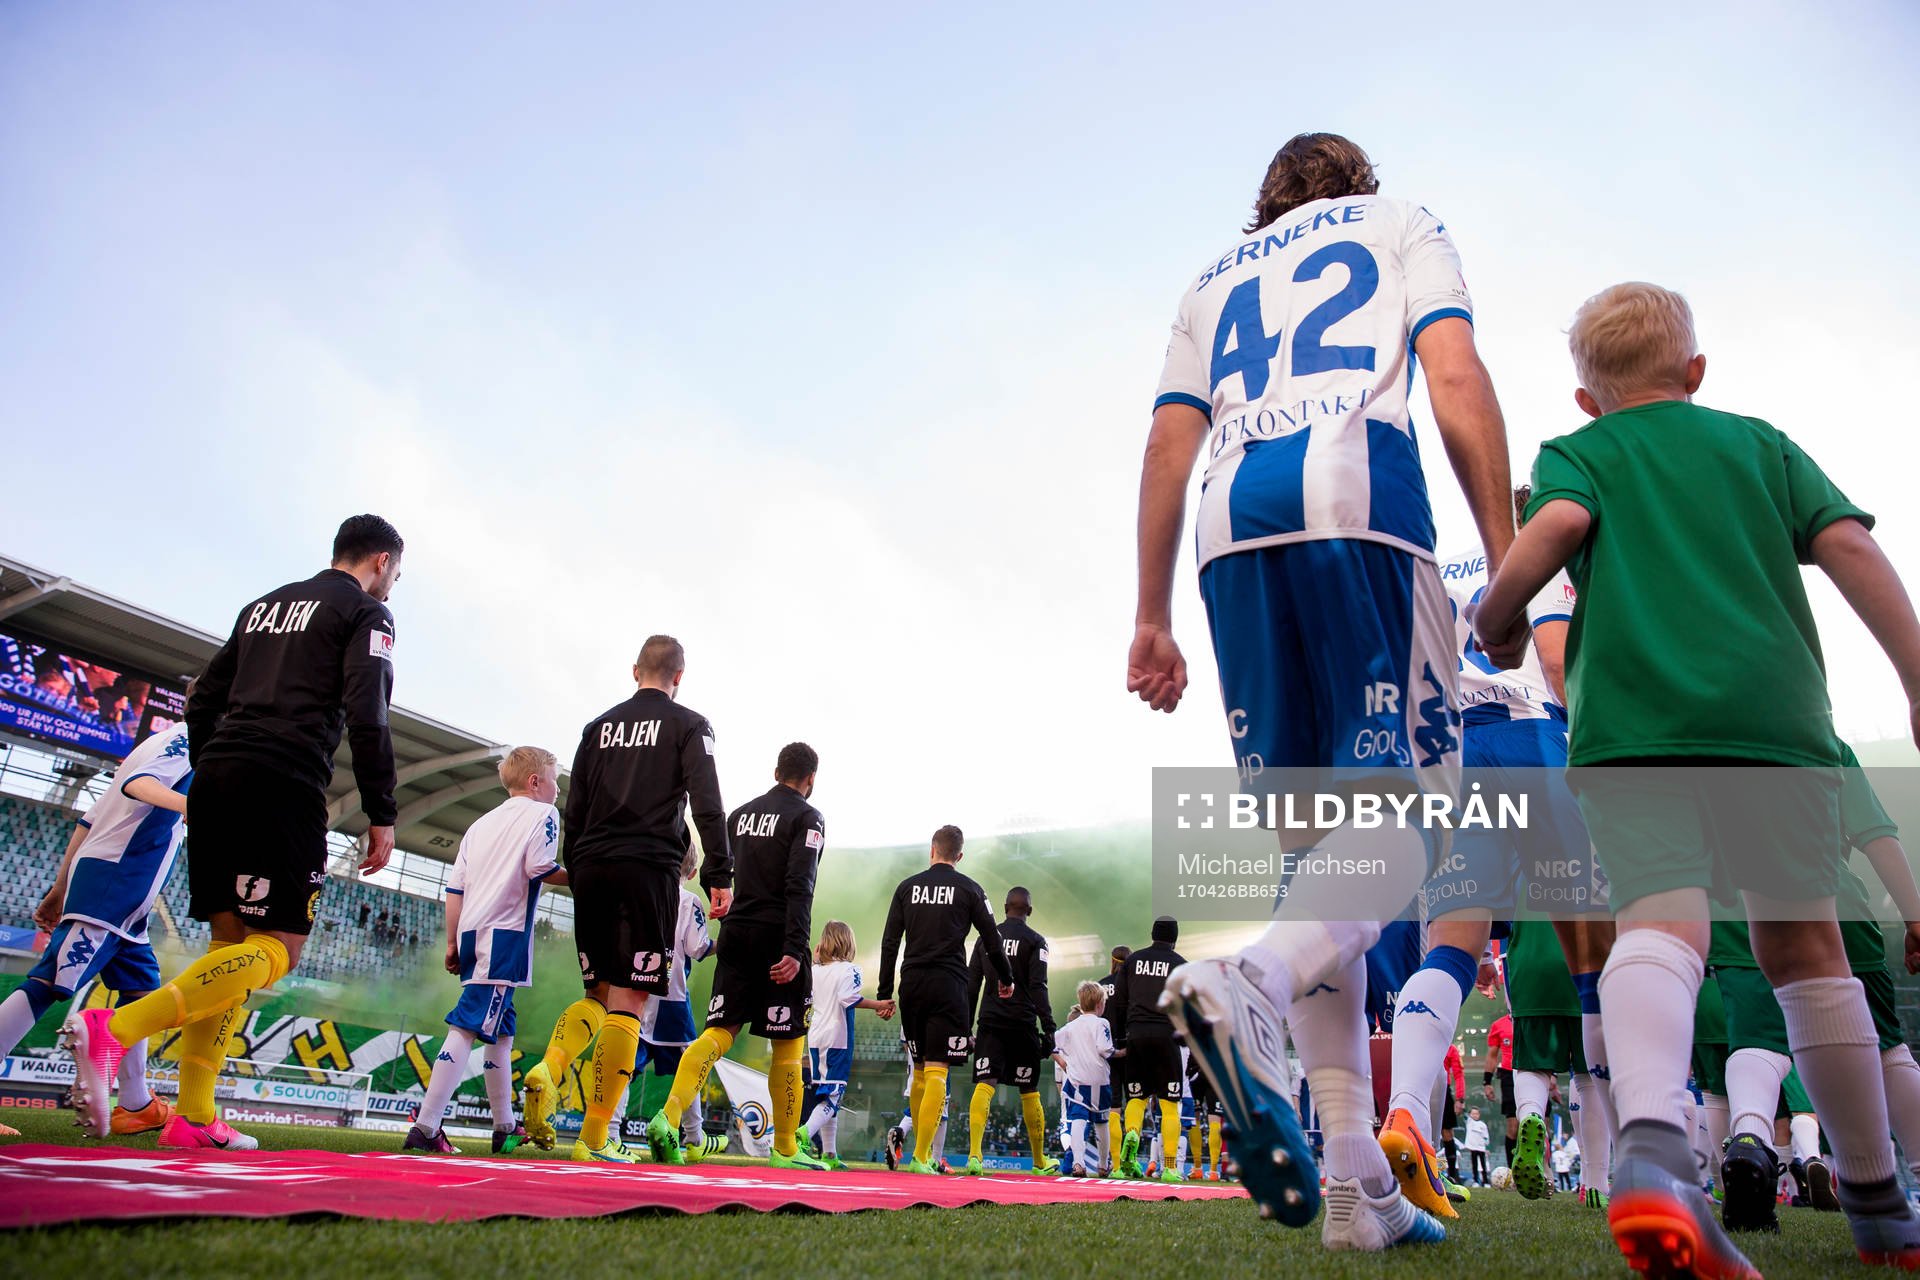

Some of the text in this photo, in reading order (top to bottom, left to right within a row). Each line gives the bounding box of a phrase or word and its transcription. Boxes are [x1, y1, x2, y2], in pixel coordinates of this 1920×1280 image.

[1196, 203, 1368, 292] SERNEKE
[1210, 240, 1379, 402] 42
[244, 600, 321, 634] BAJEN
[17, 707, 32, 718] UR
[32, 712, 54, 724] HAV
[54, 718, 77, 731] OCH
[43, 724, 54, 734] VI
[599, 719, 662, 749] BAJEN
[736, 812, 780, 837] BAJEN
[428, 835, 454, 848] B3
[1534, 859, 1582, 879] NRC
[911, 885, 955, 905] BAJEN
[1528, 882, 1587, 905] Group
[630, 972, 659, 983] fronta
[1135, 959, 1170, 977] BAJEN
[766, 1023, 791, 1032] fronta
[224, 1108, 293, 1125] Prioritet
[998, 1159, 1022, 1170] Group
[1328, 1185, 1357, 1193] umbro
